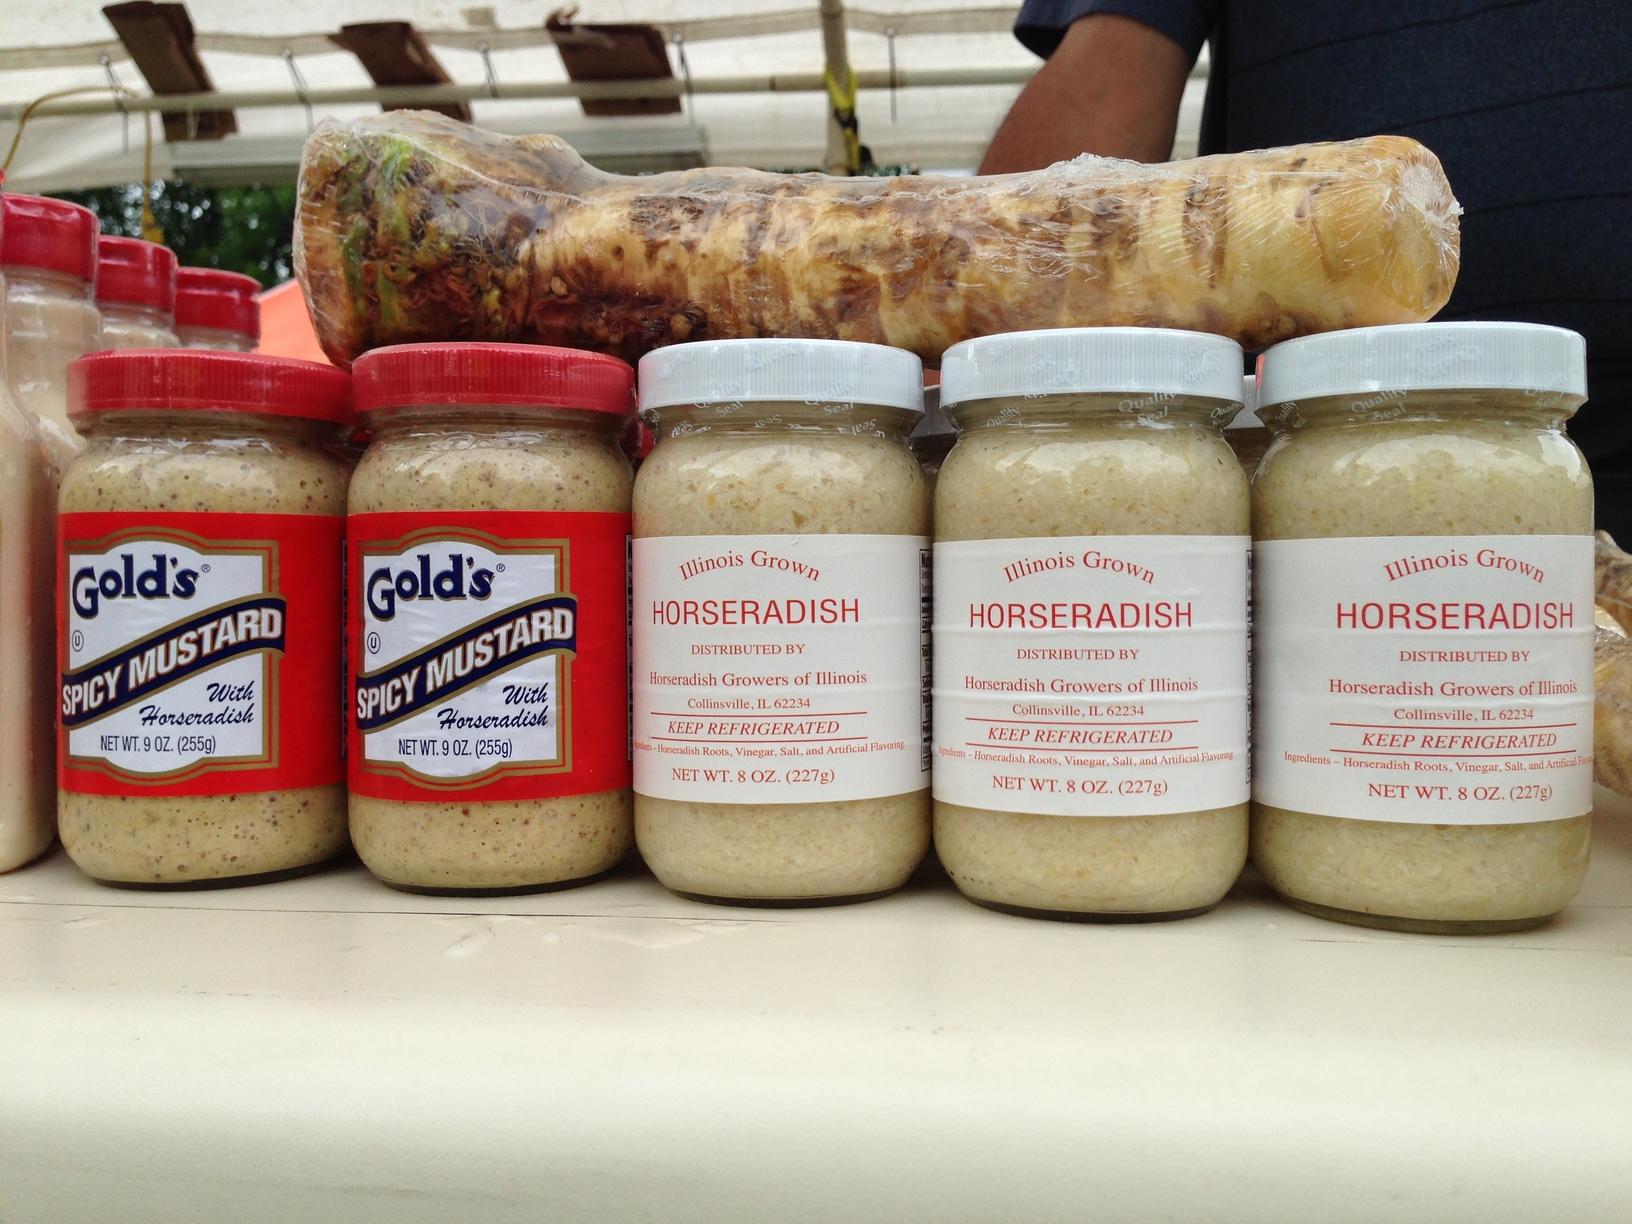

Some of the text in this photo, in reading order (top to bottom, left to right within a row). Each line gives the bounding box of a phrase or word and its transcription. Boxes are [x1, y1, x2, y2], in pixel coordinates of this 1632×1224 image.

[1117, 391, 1177, 413] Quality
[1351, 389, 1408, 414] Quality
[678, 549, 820, 581] Illinois Grown
[1003, 550, 1155, 585] Illinois Grown
[1383, 549, 1545, 584] Illinois Grown
[72, 554, 199, 619] Gold's
[367, 553, 495, 621] Gold's
[653, 598, 860, 626] HORSERADISH
[970, 602, 1192, 629] HORSERADISH
[1336, 602, 1574, 630] HORSERADISH
[691, 643, 805, 655] DISTRIBUTED BY
[1017, 648, 1139, 661] DISTRIBUTED BY
[1399, 650, 1530, 662] DISTRIBUTED BY
[62, 606, 282, 716] SPICY MUSTARD
[357, 607, 574, 720] SPICY MUSTARD
[650, 670, 867, 687] Horseradish Growers of Illinois
[965, 676, 1198, 694] Horseradish Growers of Illinois
[1329, 679, 1578, 697] Horseradish Growers of Illinois
[206, 680, 255, 703] With
[502, 682, 548, 705] With
[687, 698, 811, 711] Collinsville, IL 62234
[1012, 703, 1145, 718] Collinsville, IL 62234
[139, 703, 255, 727] Horseradish
[437, 706, 548, 730] Horseradish
[1393, 708, 1533, 722] Collinsville, IL 62234
[668, 720, 840, 736] KEEP REFRIGERATED
[988, 727, 1173, 744] KEEP REFRIGERATED
[101, 735, 216, 755] NET WT. 9 OZ. (255g)
[399, 738, 513, 758] NET WT. 9 OZ. (255g)
[657, 744, 700, 756] Horseradish
[702, 747, 733, 757] Roots,
[735, 747, 778, 758] Vinegar,
[780, 746, 803, 757] Salt,
[805, 746, 824, 756] and
[826, 743, 868, 755] Artificial
[1362, 732, 1557, 749] KEEP REFRIGERATED
[974, 750, 1025, 764] Horseradish
[1028, 754, 1061, 766] Roots,
[1065, 755, 1109, 768] Vinegar,
[1112, 756, 1137, 767] Salt,
[1140, 755, 1158, 766] and
[1160, 753, 1200, 765] Artificial
[1284, 751, 1331, 765] Ingredients
[1343, 757, 1410, 771] Horseradish
[1414, 761, 1453, 772] Roots,
[1456, 761, 1502, 774] Vinegar,
[1504, 761, 1527, 772] Salt,
[1529, 760, 1544, 771] and
[1546, 757, 1577, 769] Artificial
[672, 767, 835, 785] NET WT. 8 OZ. (227g)
[992, 775, 1168, 796] NET WT. 8 OZ. (227g)
[1368, 783, 1553, 802] NET WT. 8 OZ. (227g)
